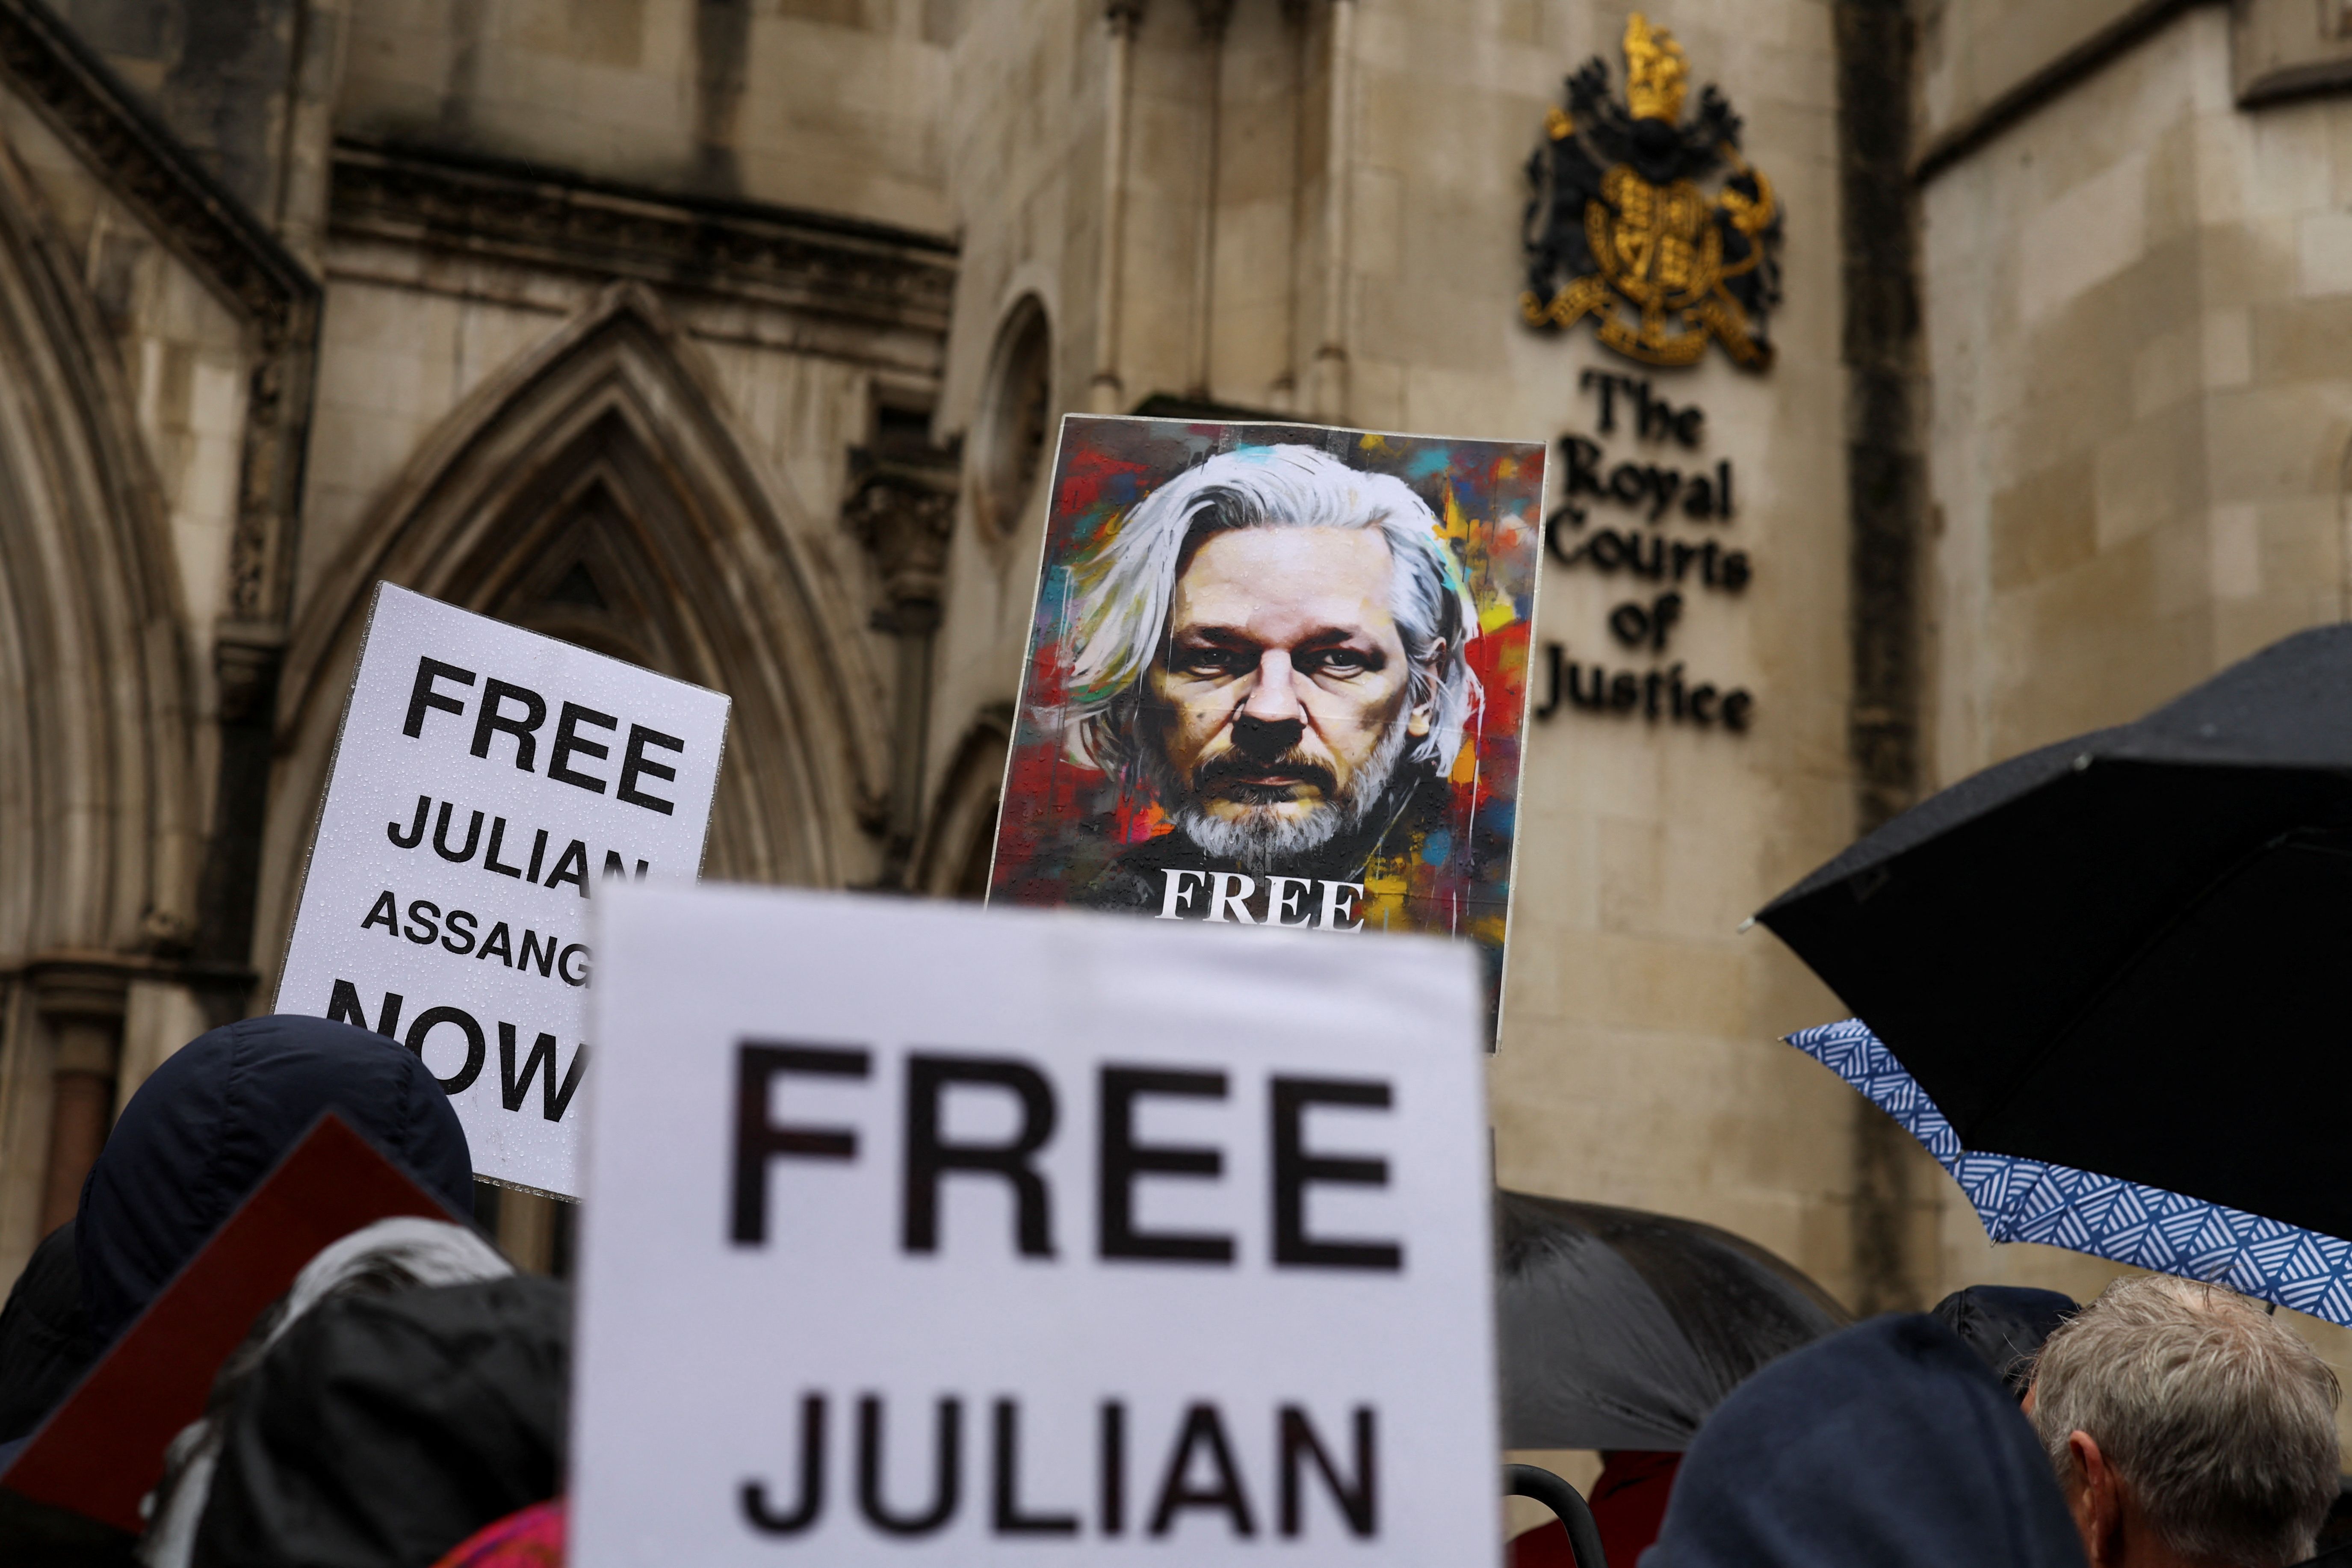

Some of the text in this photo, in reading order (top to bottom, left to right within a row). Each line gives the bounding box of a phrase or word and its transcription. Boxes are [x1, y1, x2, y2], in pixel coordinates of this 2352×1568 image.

[1579, 366, 1704, 449] The
[1558, 433, 1734, 523] Royal
[1545, 505, 1752, 593] Courts
[1609, 591, 1683, 649] of
[1536, 643, 1752, 732] Justice
[402, 656, 685, 816] FREE
[360, 890, 593, 989] ASSANG
[1155, 868, 1364, 934] FREE
[728, 1038, 1404, 1273] FREE
[738, 1391, 1378, 1539] JULIAN
